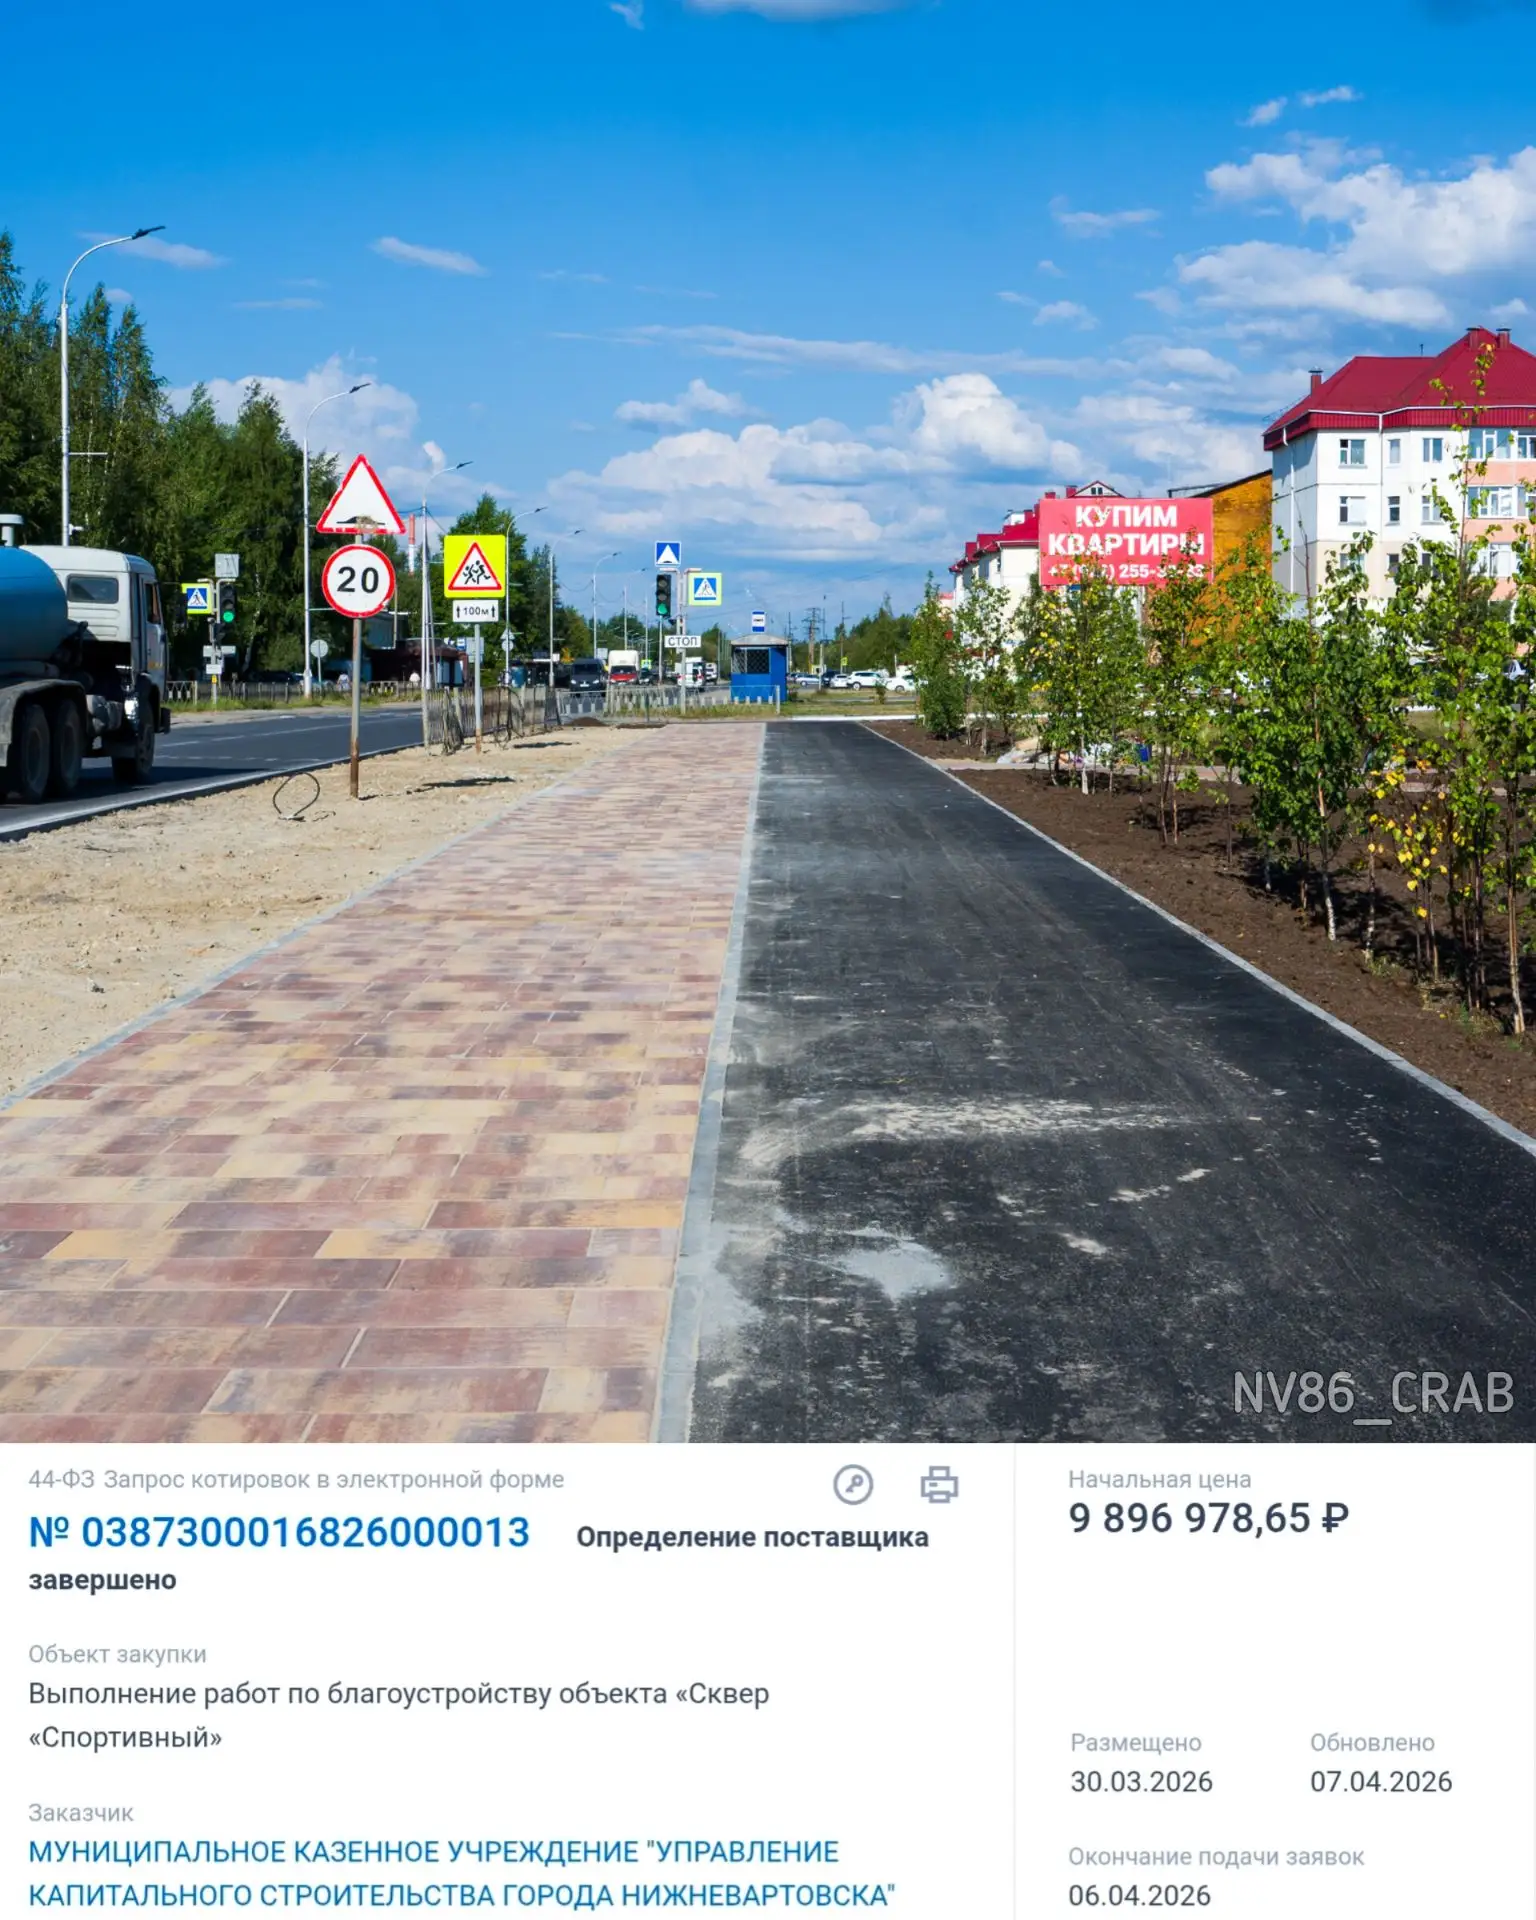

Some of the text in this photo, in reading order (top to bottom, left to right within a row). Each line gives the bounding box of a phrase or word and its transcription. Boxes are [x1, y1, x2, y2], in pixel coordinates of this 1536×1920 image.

[1075, 505, 1178, 528] КУПИМ
[1048, 532, 1205, 556] КВАРТИРЫ
[336, 566, 379, 594] 20
[668, 636, 698, 646] СТОП
